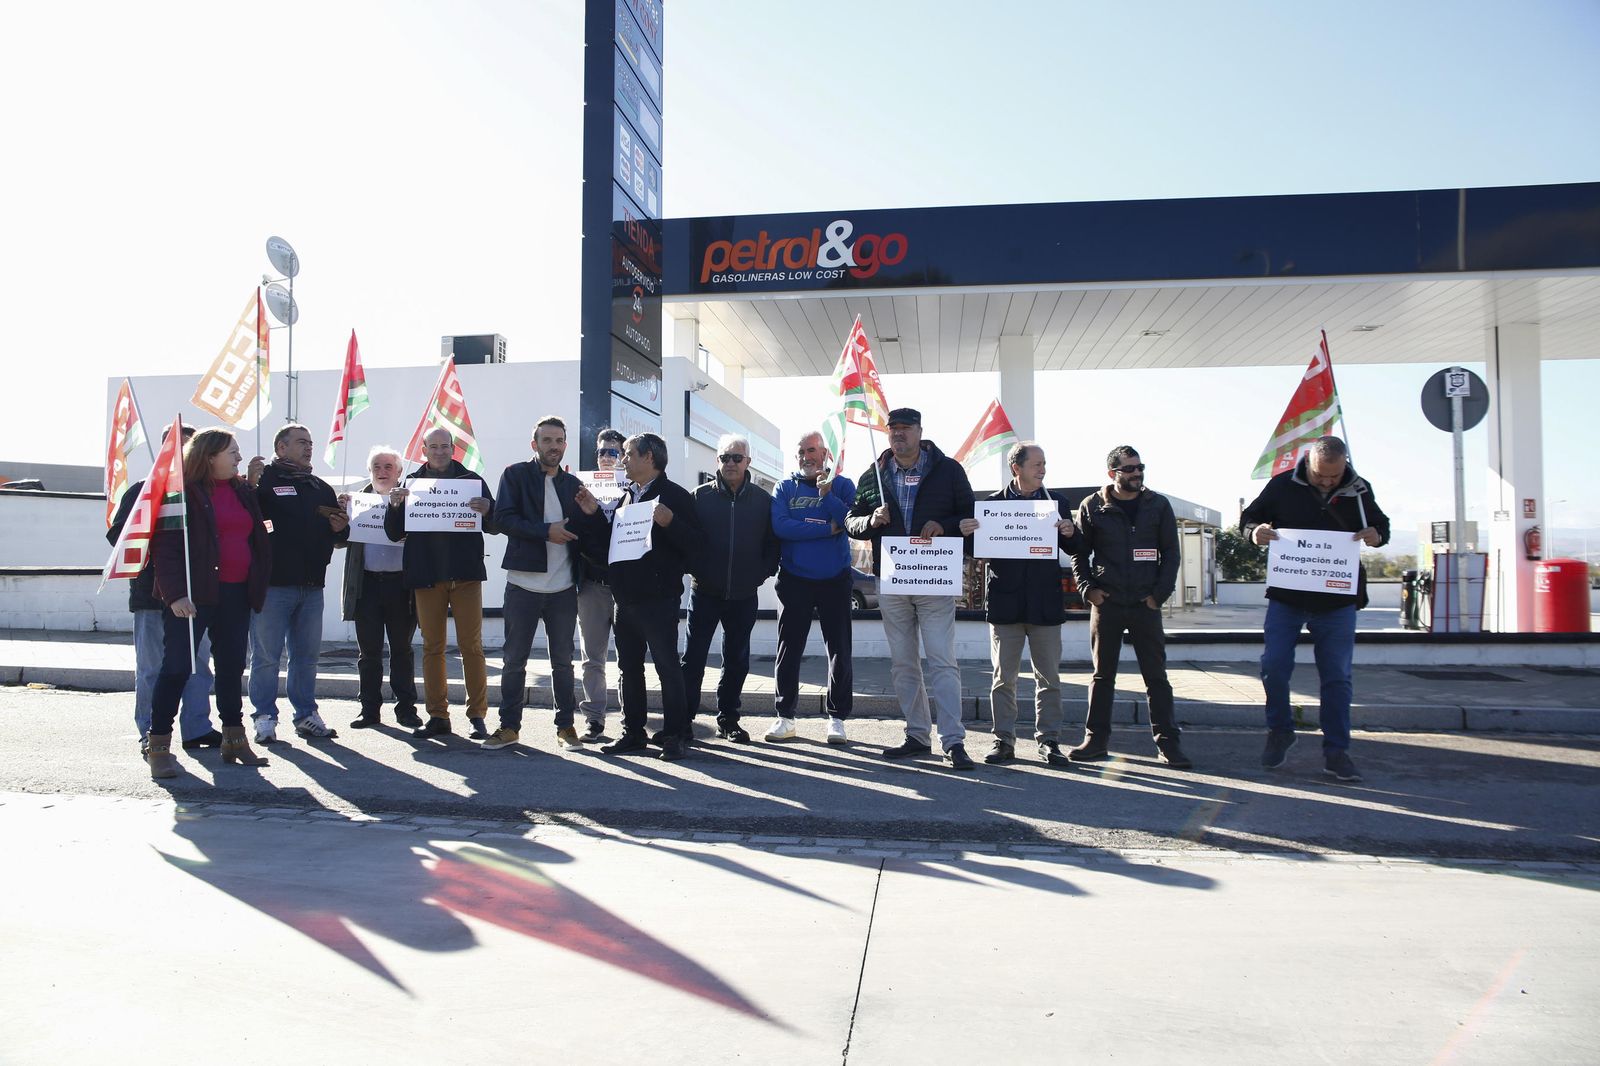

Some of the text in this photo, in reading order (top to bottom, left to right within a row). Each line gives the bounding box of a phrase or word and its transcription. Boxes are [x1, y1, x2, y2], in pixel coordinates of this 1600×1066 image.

[622, 205, 655, 265] TIENDA
[712, 269, 846, 283] GASOLINERAS LOW COST
[625, 324, 651, 351] AUTOPAGO
[429, 487, 441, 495] No
[354, 500, 369, 508] Por
[414, 501, 458, 509] derogación
[984, 509, 999, 517] Por
[989, 534, 1043, 542] consumidores
[1297, 539, 1312, 548] No
[890, 546, 953, 556] Por el empleo
[1280, 553, 1347, 565] derogación del
[895, 563, 948, 571] Gasolineras
[1273, 566, 1352, 579] decreto 537/2004
[892, 577, 953, 586] Desatendidas
